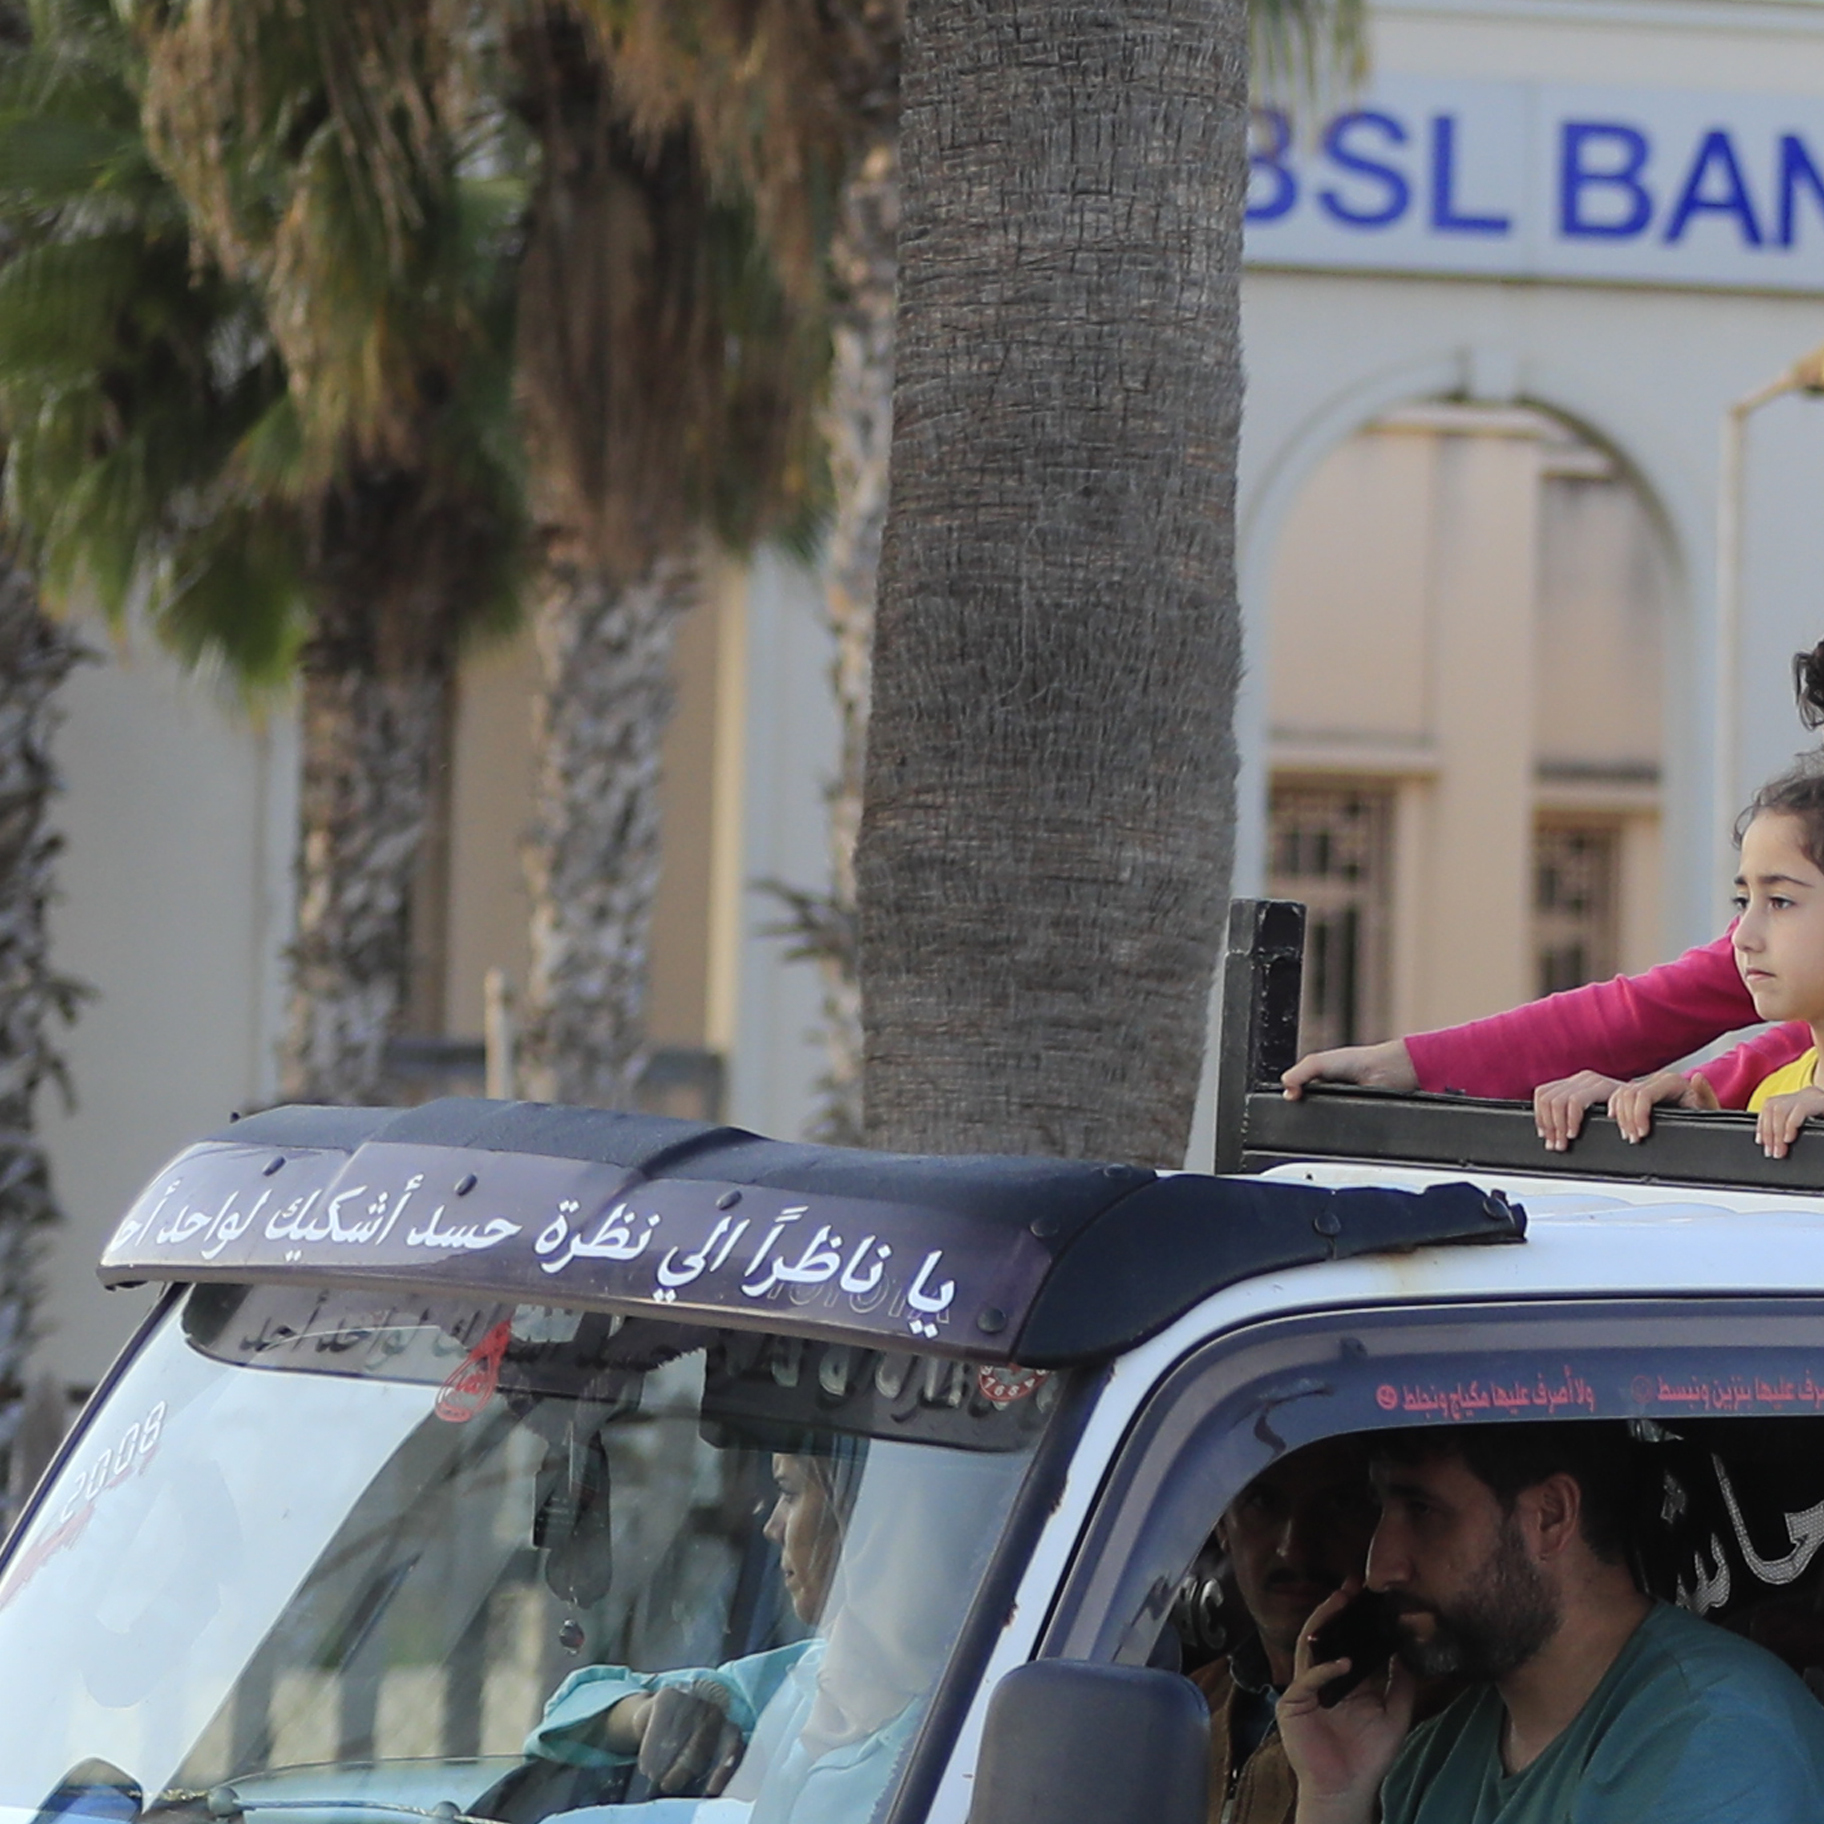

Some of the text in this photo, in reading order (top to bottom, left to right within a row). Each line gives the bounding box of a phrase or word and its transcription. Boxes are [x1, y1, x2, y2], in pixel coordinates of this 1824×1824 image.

[1245, 106, 1512, 238] BSL
[155, 1188, 273, 1261] لواحد
[264, 1172, 425, 1263] أشكيك
[406, 1203, 524, 1251] حسد
[534, 1198, 662, 1276] نظرة
[907, 1249, 956, 1340] يا
[59, 1401, 167, 1524] 2008
